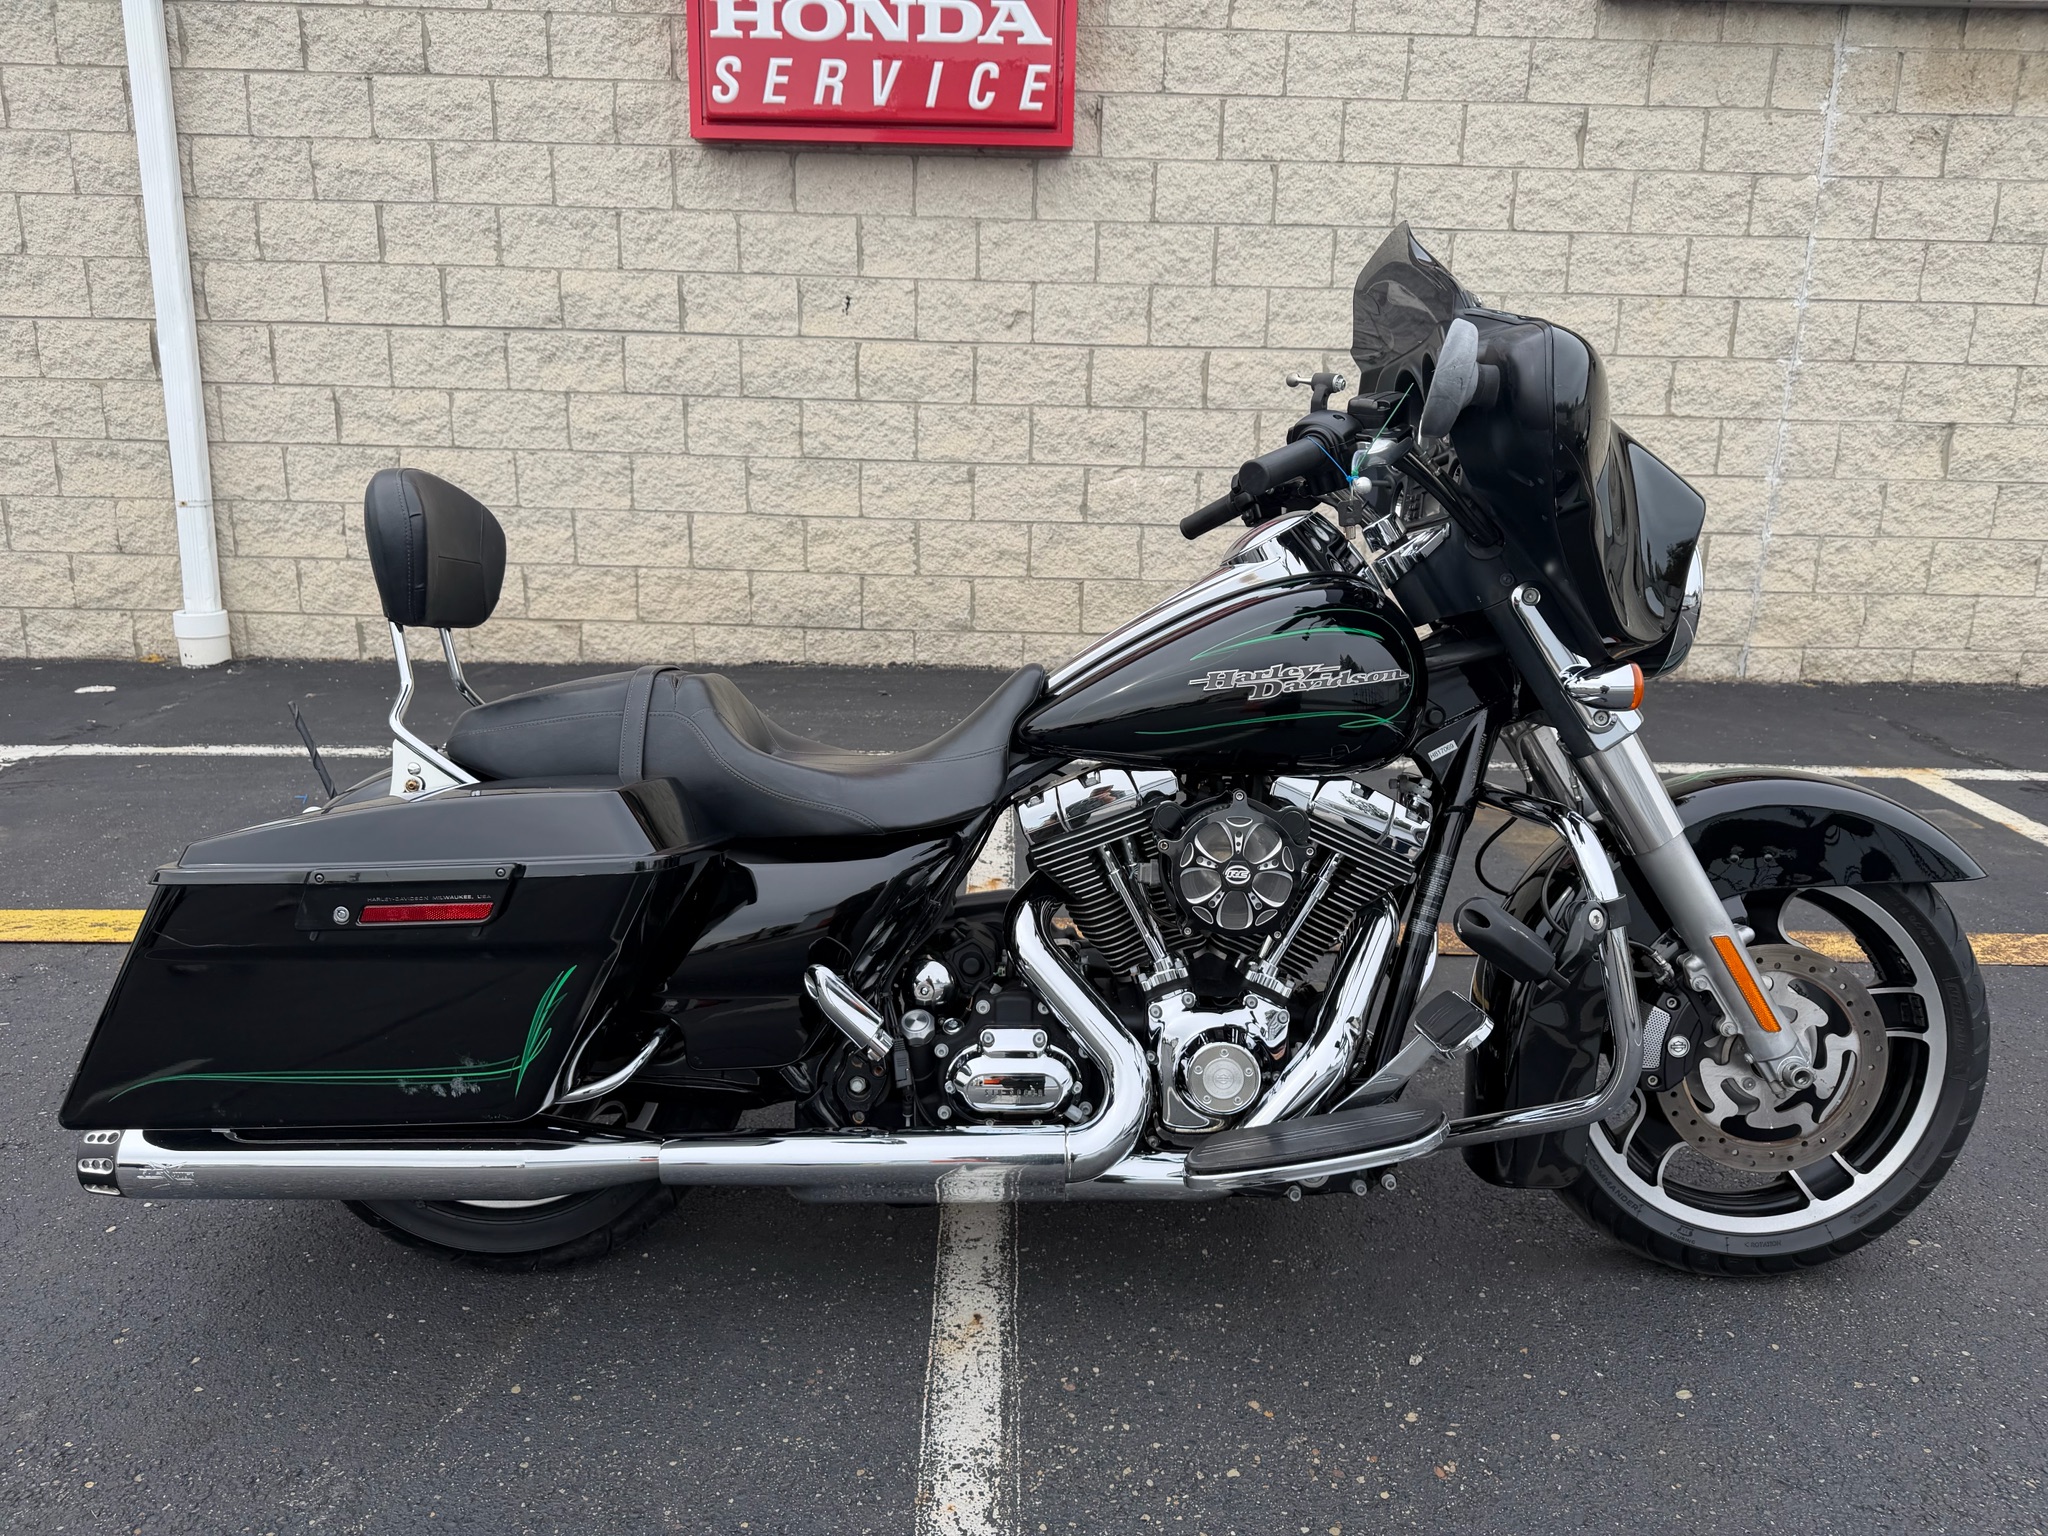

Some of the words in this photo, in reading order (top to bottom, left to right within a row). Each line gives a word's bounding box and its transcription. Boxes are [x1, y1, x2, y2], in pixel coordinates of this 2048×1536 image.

[710, 0, 1053, 45] HONDA
[712, 55, 1052, 111] SERVICE
[1190, 663, 1340, 691] Harley
[1245, 668, 1409, 700] Davidson
[1589, 1159, 1639, 1211] COMMANDER
[1669, 1231, 1696, 1245] TOURING
